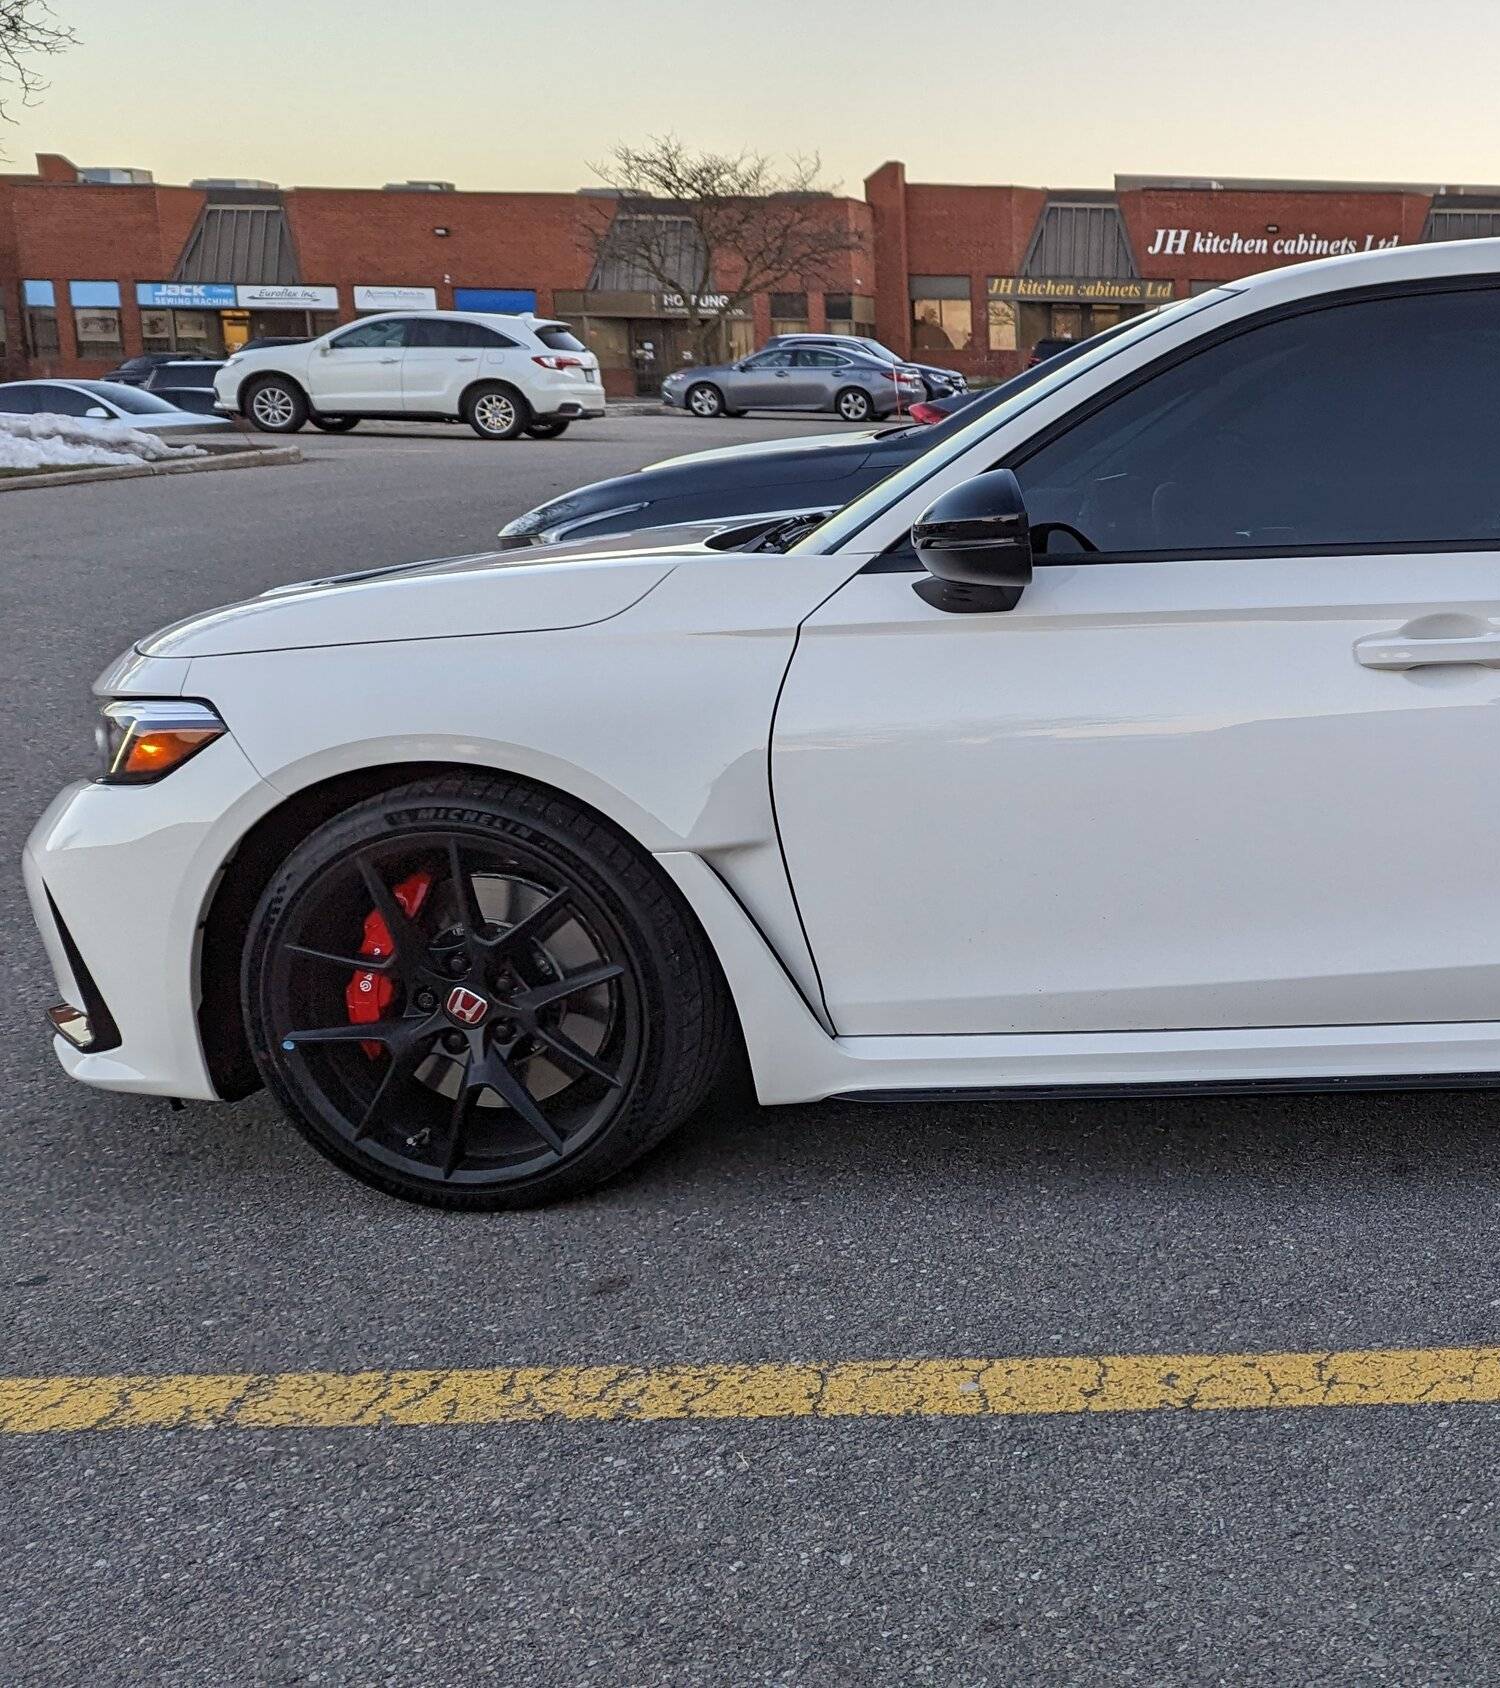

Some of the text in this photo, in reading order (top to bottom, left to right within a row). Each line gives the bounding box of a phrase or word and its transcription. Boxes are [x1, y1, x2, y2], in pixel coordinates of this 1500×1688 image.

[1147, 229, 1191, 255] JH
[1192, 232, 1268, 255] kitchen
[1272, 233, 1357, 255] cabinets
[988, 278, 1173, 298] JH kitchen cabinets Ltd
[154, 296, 191, 305] SEWING
[416, 806, 533, 840] MICHELIN
